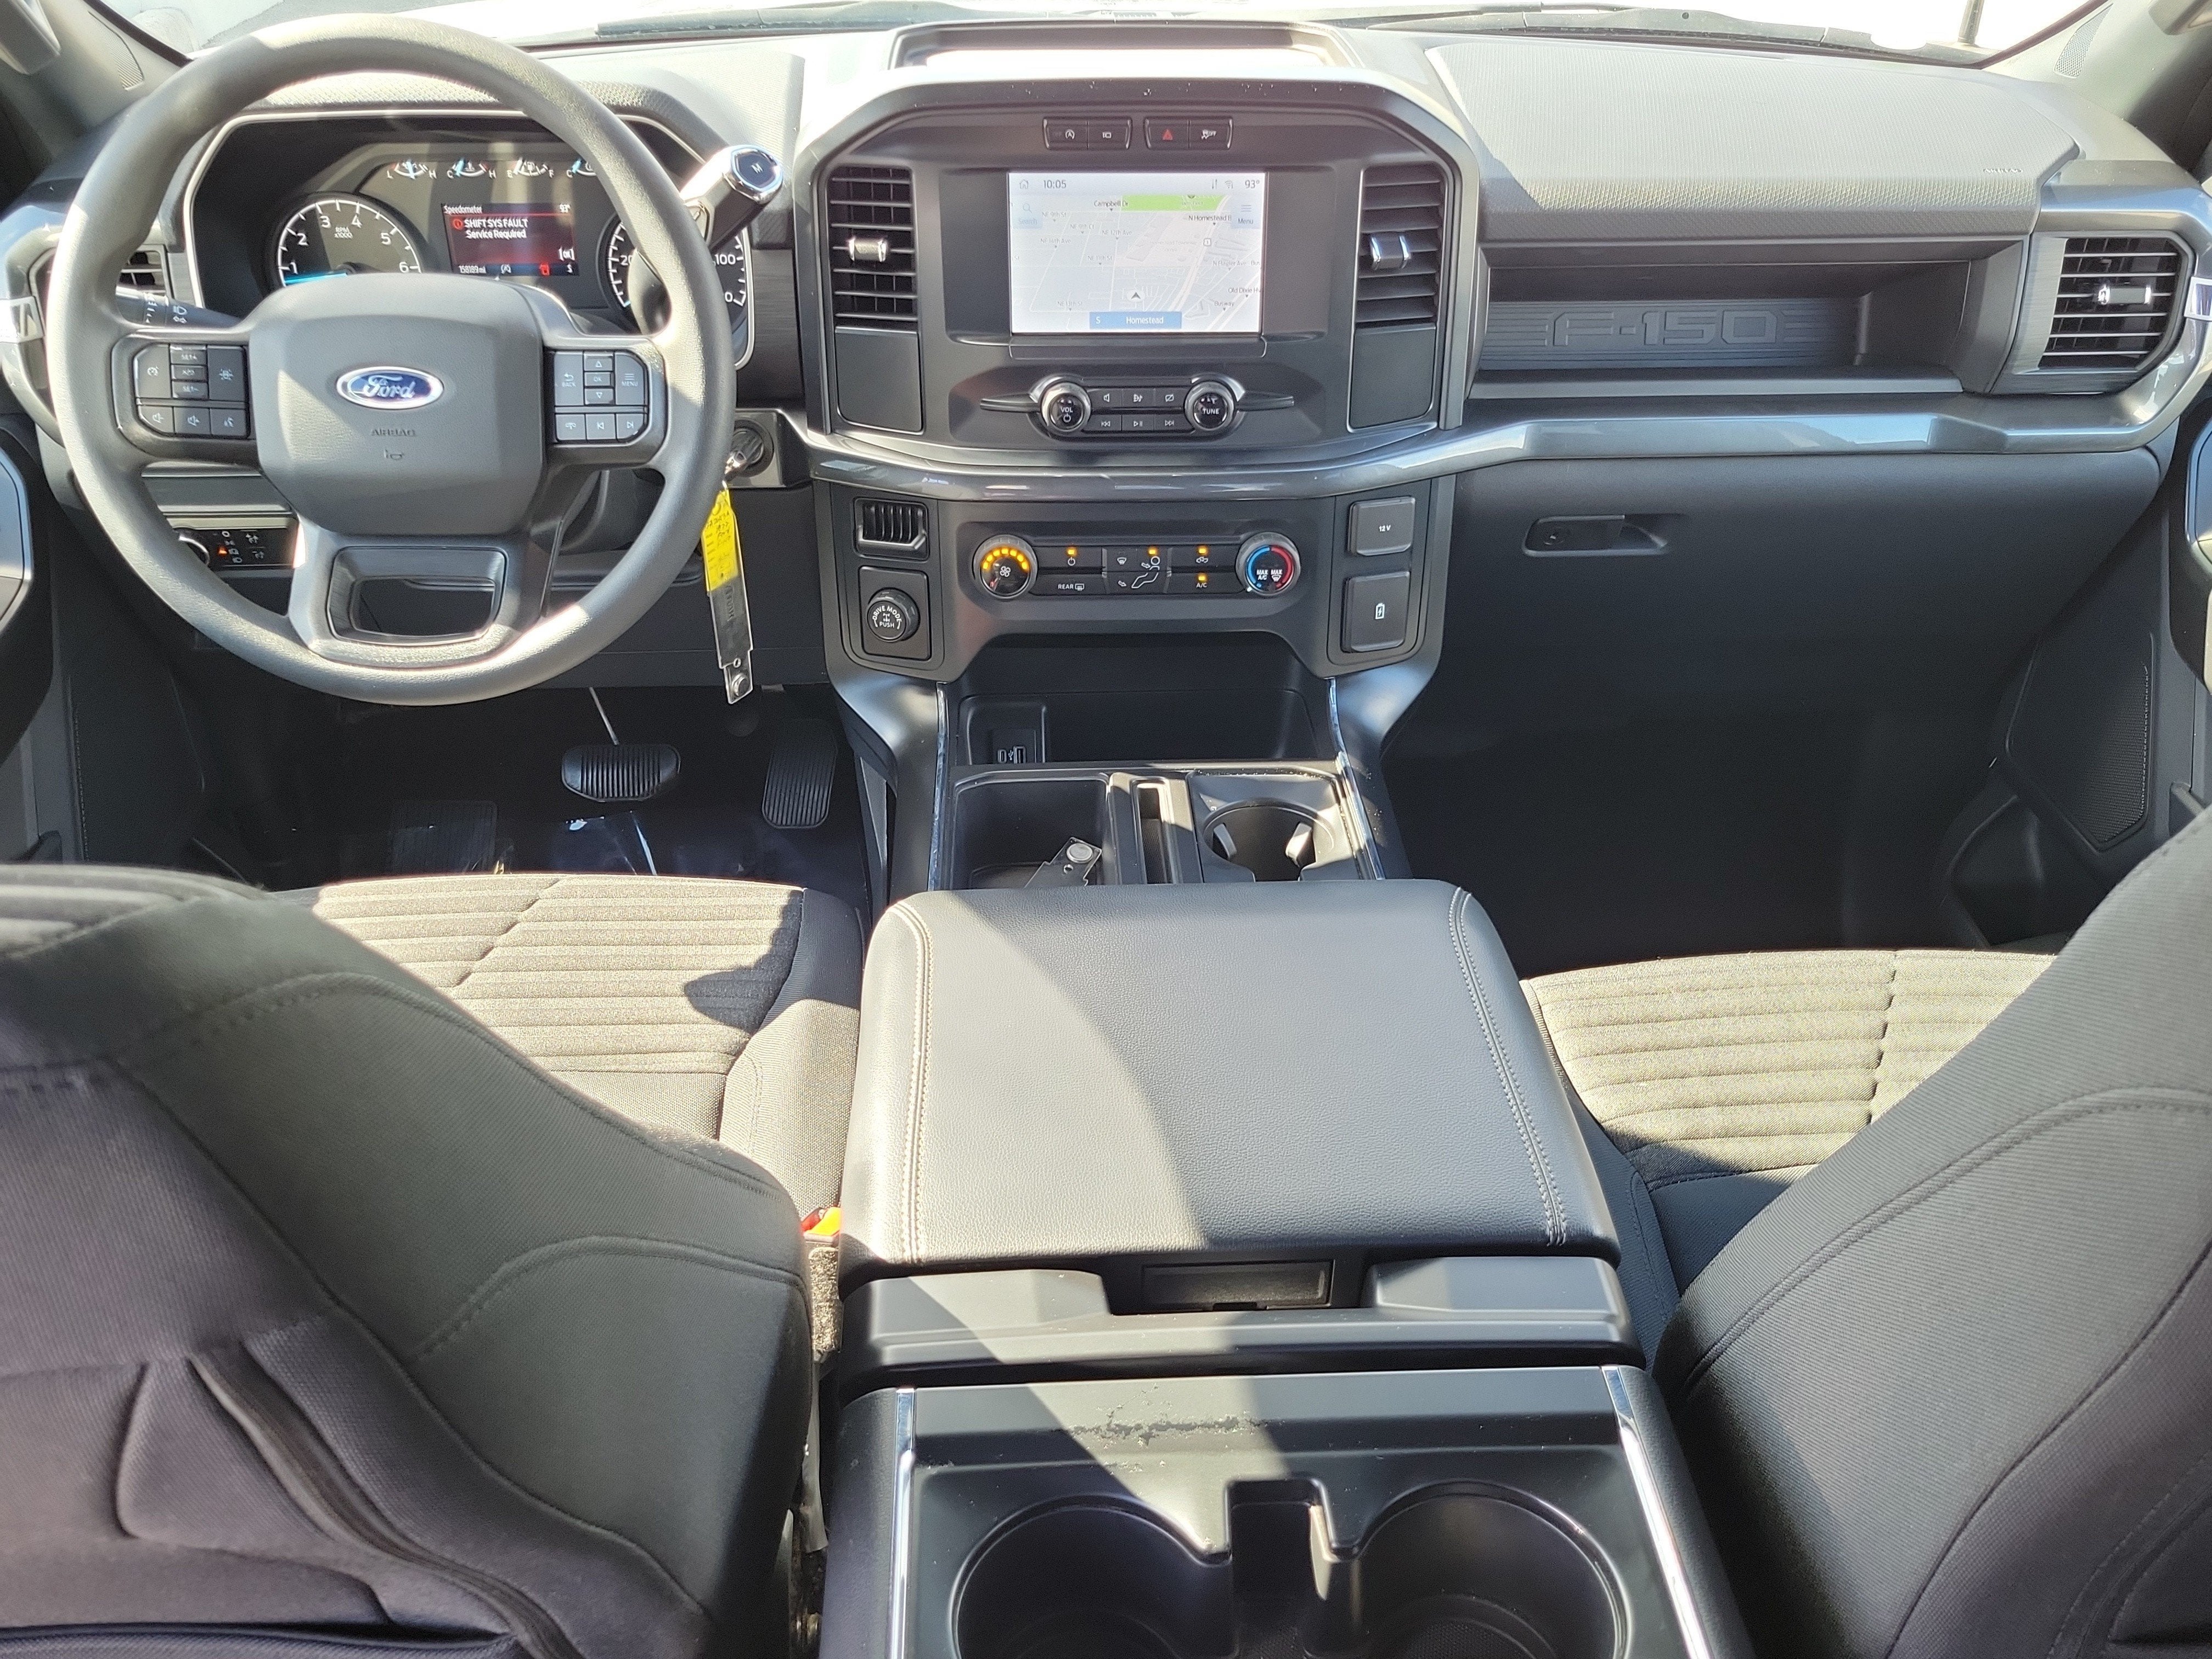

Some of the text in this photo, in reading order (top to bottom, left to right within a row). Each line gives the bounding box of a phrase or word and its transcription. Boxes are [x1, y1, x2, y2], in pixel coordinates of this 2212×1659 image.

[430, 170, 437, 179] H
[447, 170, 454, 179] C
[489, 170, 496, 179] H
[507, 170, 514, 178] E
[566, 170, 573, 178] C
[1043, 179, 1066, 189] 10:05
[444, 205, 482, 214] Speedometer
[1094, 200, 1121, 208] Campbell
[320, 216, 331, 229] 3
[351, 215, 362, 228] 4
[465, 218, 528, 228] SHIFT SYS FAULT
[297, 233, 309, 246] 2
[381, 232, 392, 245] 5
[466, 229, 527, 240] Service Required
[290, 261, 298, 274] 1
[399, 262, 409, 273] 6
[1553, 309, 1778, 347] F-150
[363, 375, 416, 398] Ford
[872, 605, 902, 623] DRIVE MODE
